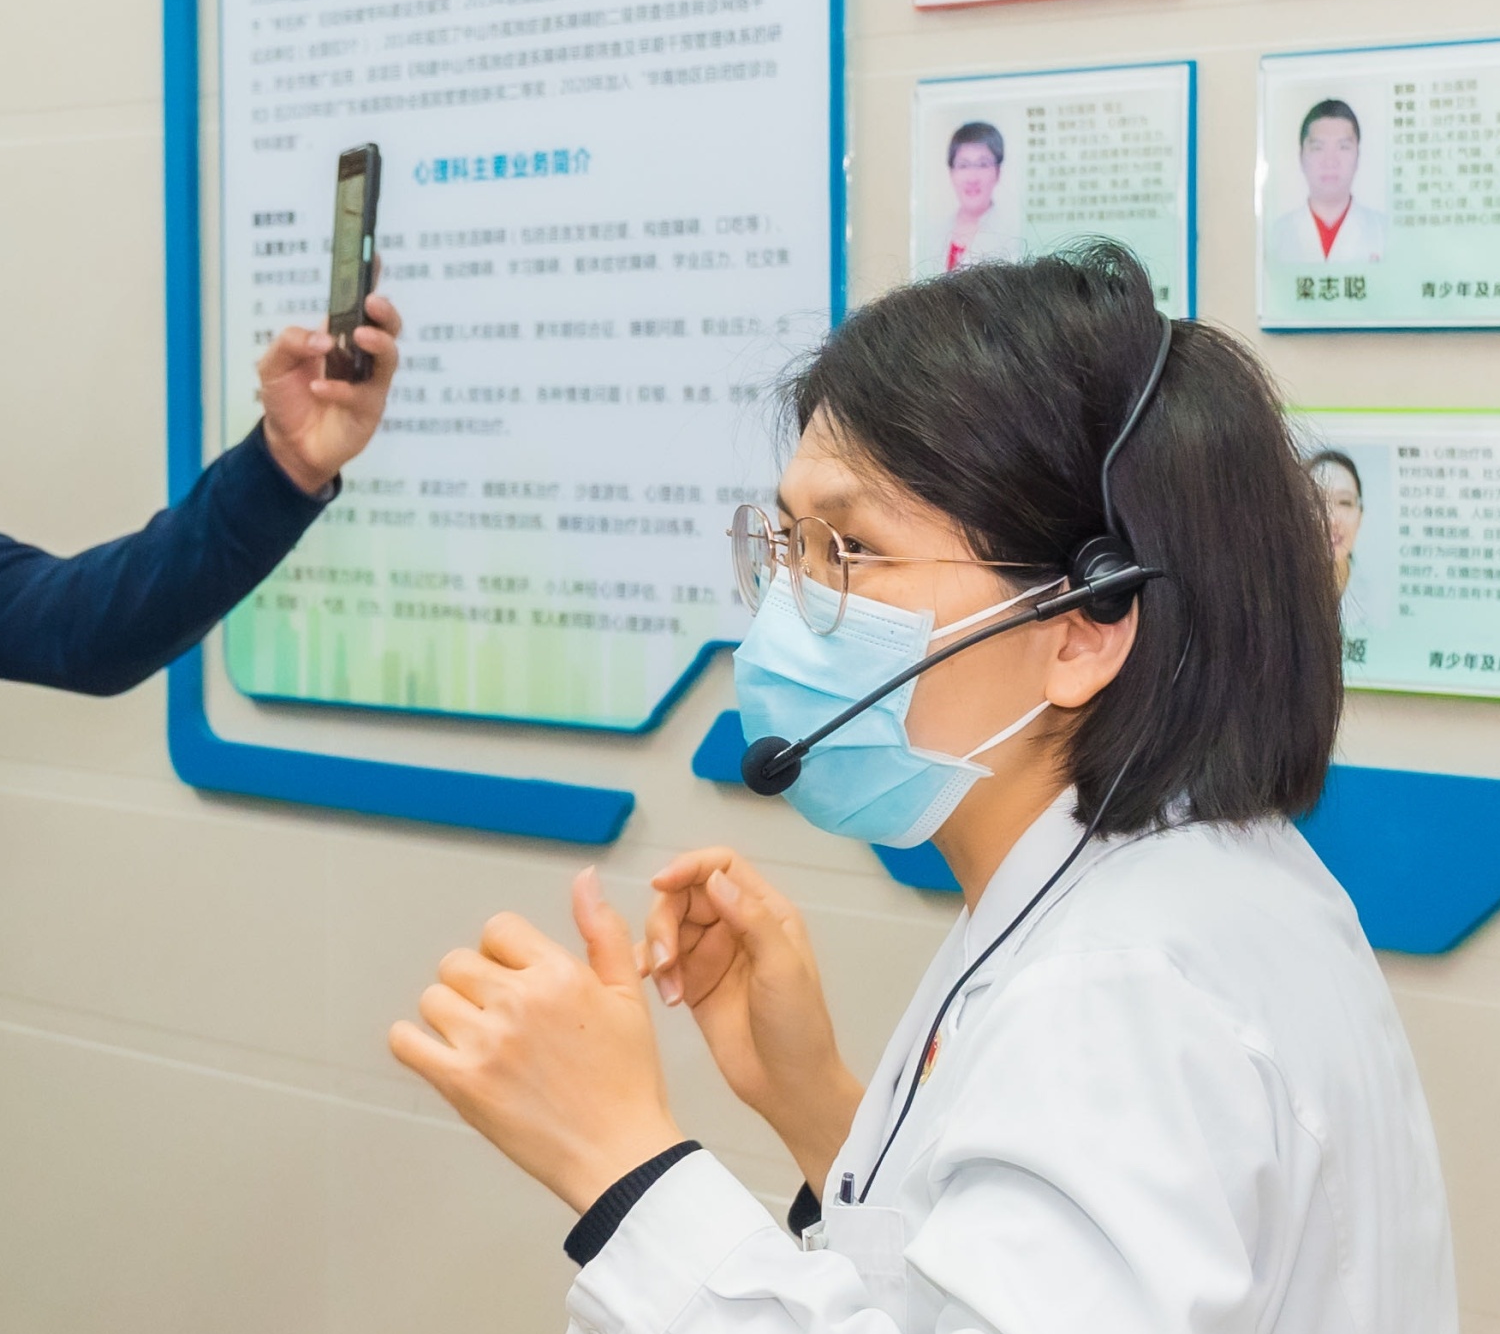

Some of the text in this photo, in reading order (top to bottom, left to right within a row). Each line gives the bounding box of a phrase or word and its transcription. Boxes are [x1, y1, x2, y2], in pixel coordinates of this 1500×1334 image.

[414, 148, 592, 186] 心理科主要业务简介
[1296, 275, 1367, 301] 梁志聪
